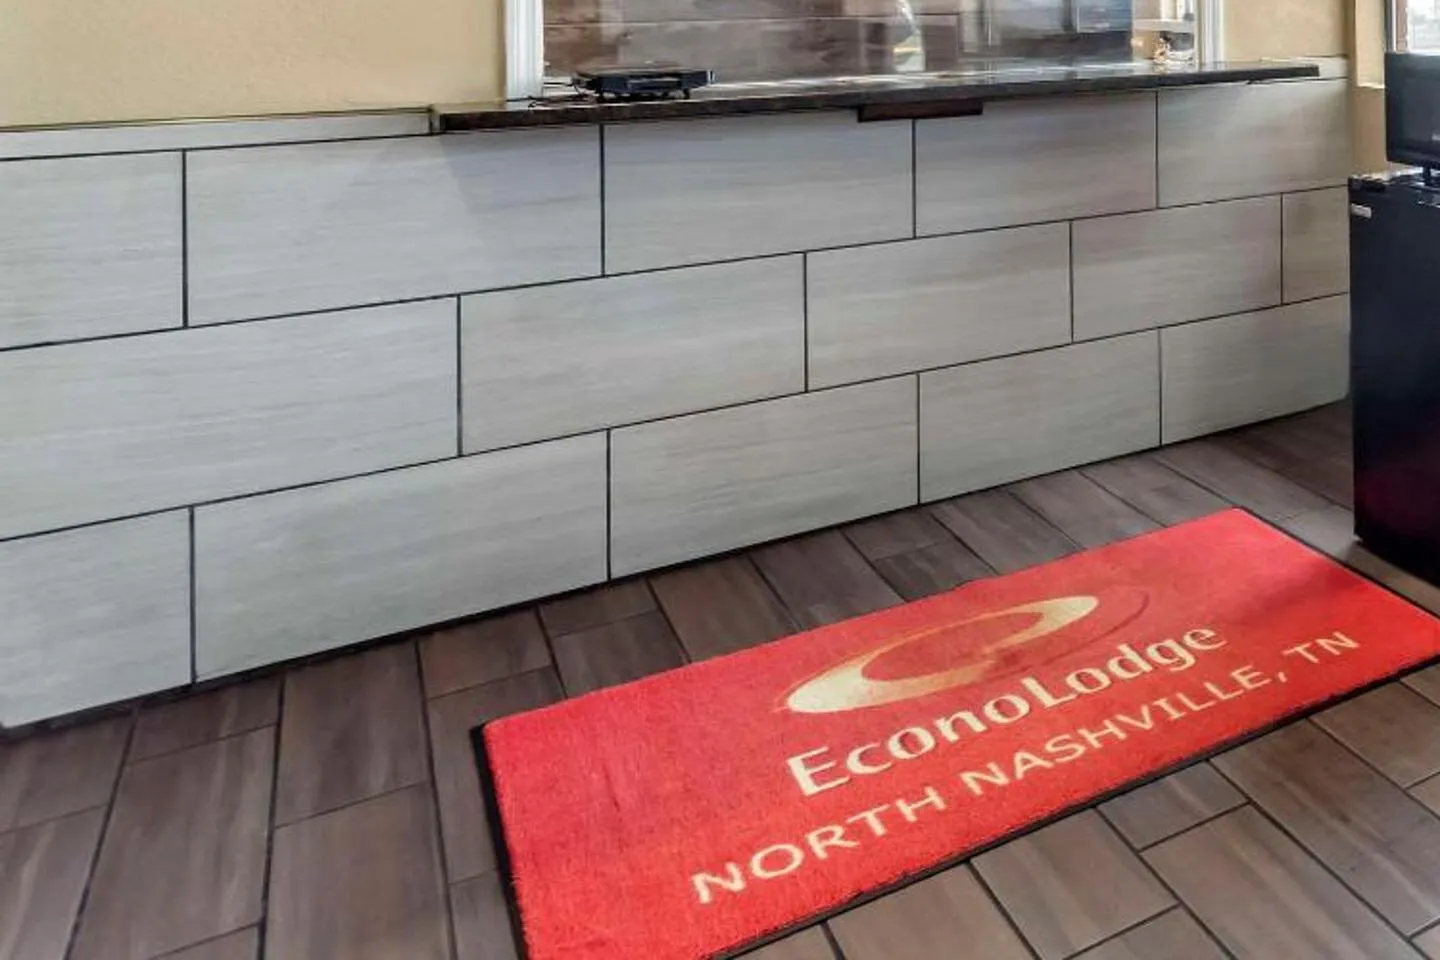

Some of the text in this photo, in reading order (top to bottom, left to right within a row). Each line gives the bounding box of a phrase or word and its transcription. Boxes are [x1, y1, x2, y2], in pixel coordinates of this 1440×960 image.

[691, 630, 1361, 904] NORTH NASHVILLE, TN
[785, 623, 1228, 798] EconoLodge
